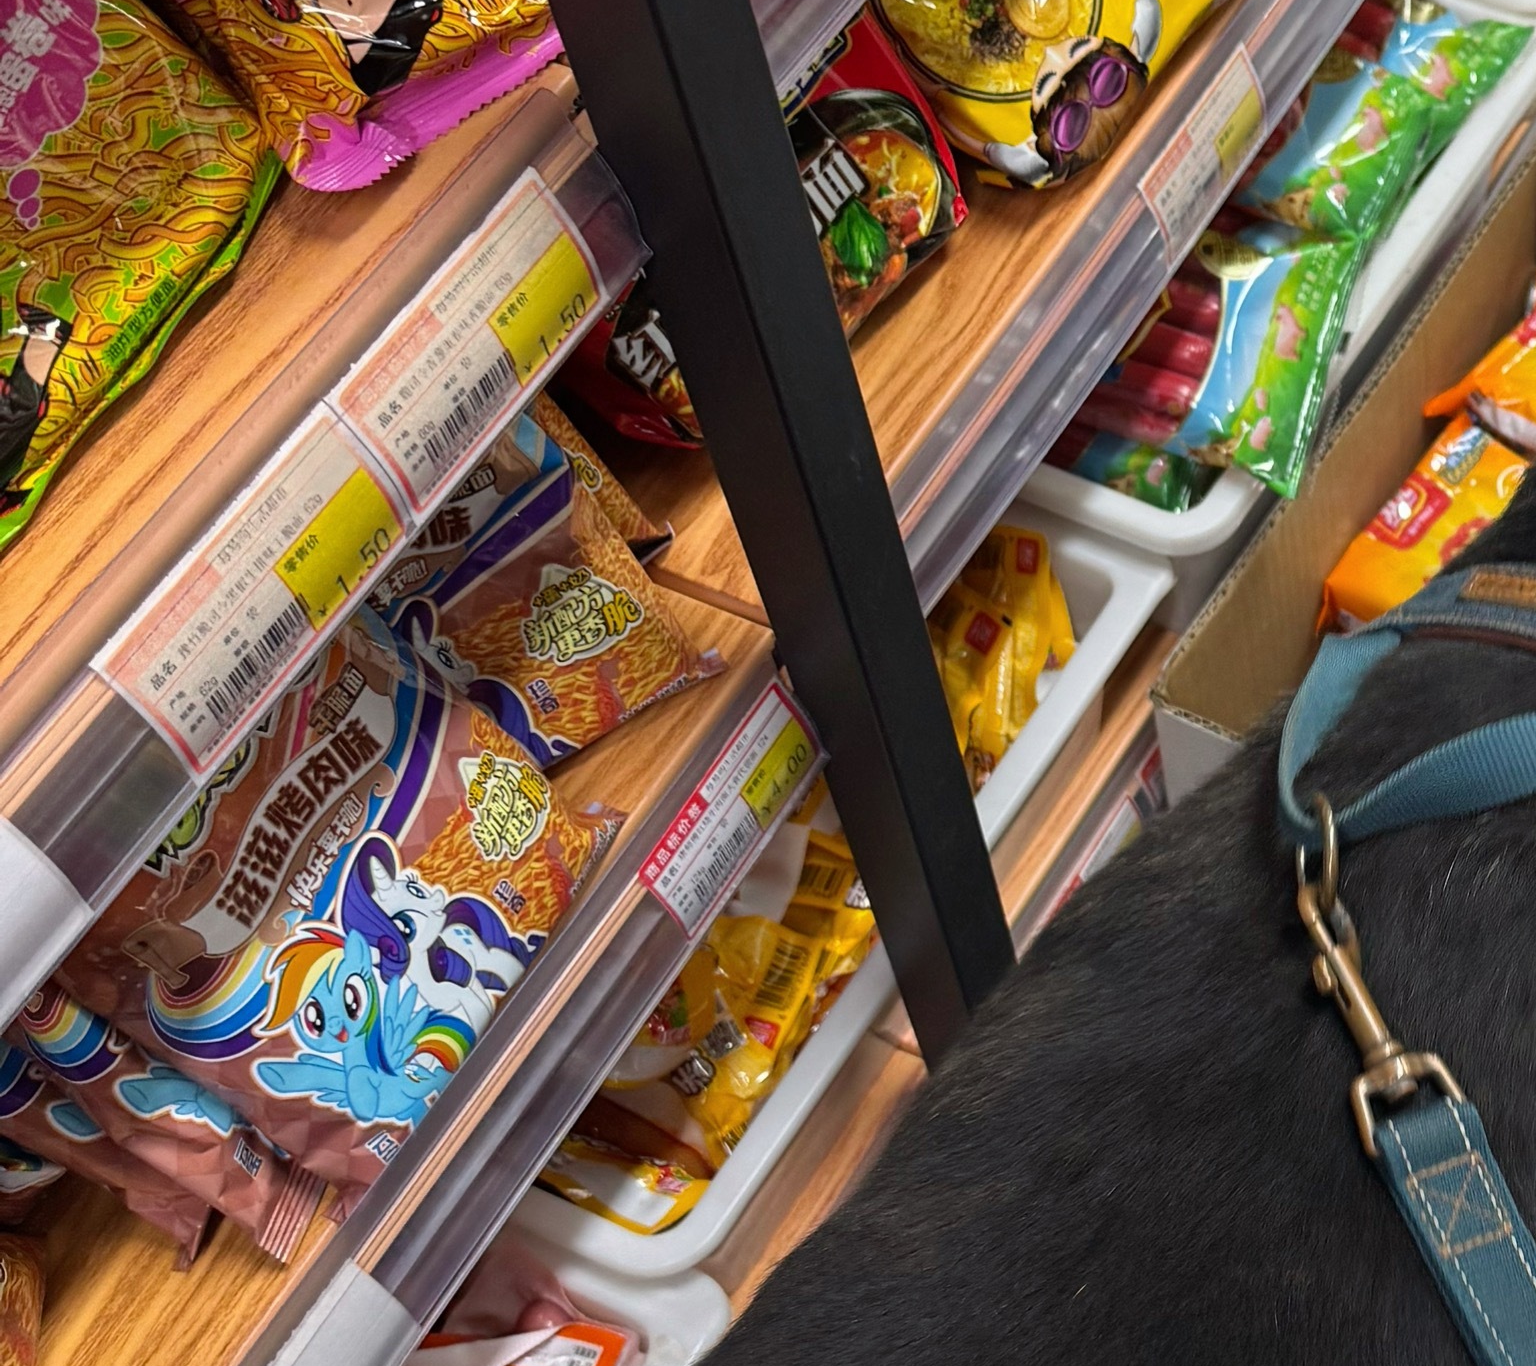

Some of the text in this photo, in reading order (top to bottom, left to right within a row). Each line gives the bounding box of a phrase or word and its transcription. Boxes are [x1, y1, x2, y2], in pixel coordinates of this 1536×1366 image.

[495, 290, 531, 329] 零售价
[535, 292, 589, 357] 1.50
[376, 399, 402, 428] 品名
[282, 531, 320, 575] 零售价
[333, 526, 393, 596] 1.50
[148, 658, 178, 690] 品名
[302, 491, 324, 515] 62g
[521, 585, 603, 655] 新配方
[554, 592, 639, 661] 更香脆
[198, 675, 220, 697] 62g
[308, 662, 368, 736] 干脆面
[216, 716, 385, 932] 滋滋烤肉味
[470, 767, 520, 852] 新配方
[499, 768, 551, 854] 更香脆
[644, 801, 703, 880] 商品标价签
[286, 794, 362, 913] 快乐要干脆!
